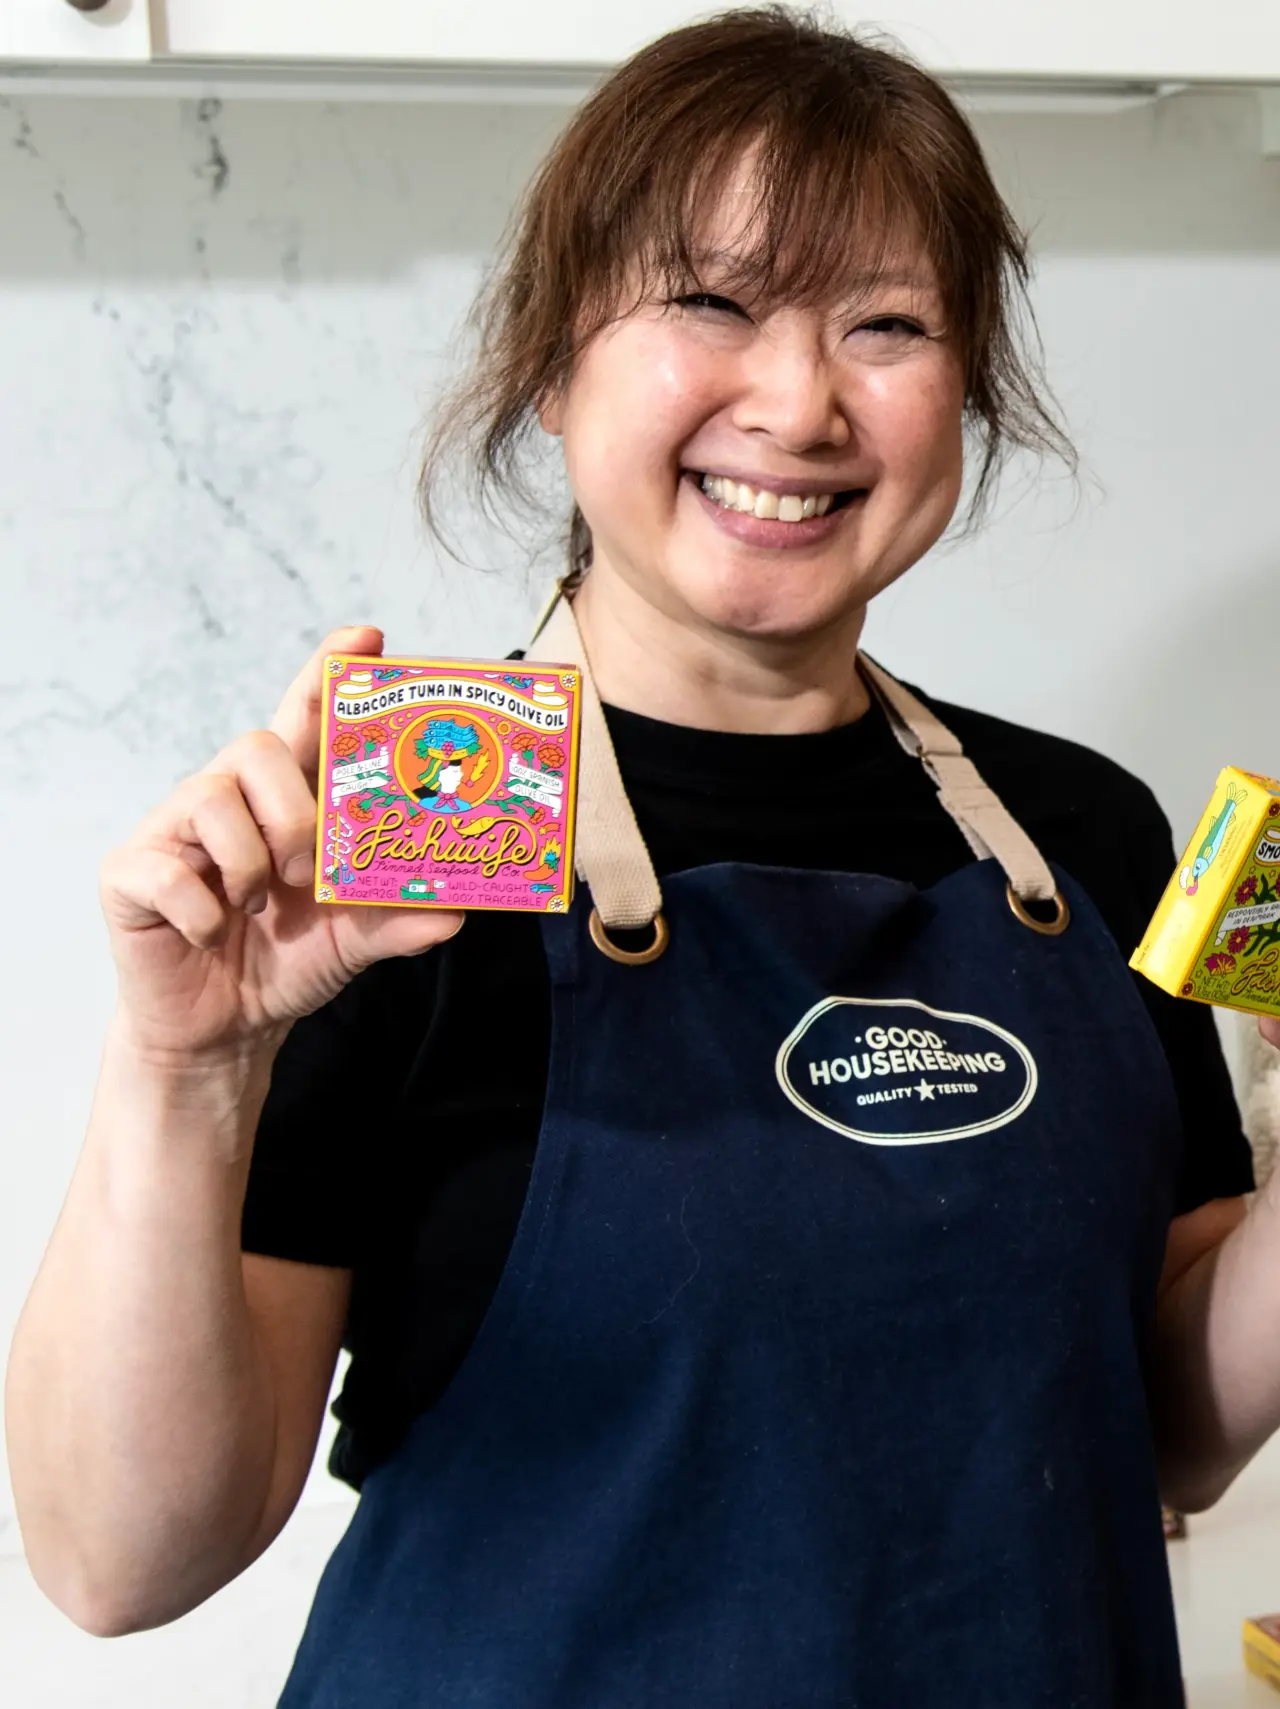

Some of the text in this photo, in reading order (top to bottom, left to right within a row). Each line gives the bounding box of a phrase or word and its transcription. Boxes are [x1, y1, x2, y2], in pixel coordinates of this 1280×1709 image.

[337, 684, 565, 727] ALBACORE TUNA IN SPICY OLIVE OIL
[515, 785, 537, 798] OLIVE
[352, 809, 537, 877] Fishwife
[426, 863, 480, 877] Seafood
[357, 876, 378, 886] NET
[448, 881, 529, 893] WILD-CAUGHT
[448, 893, 542, 906] 100% TRACEABLE
[865, 1026, 943, 1050] GOOD
[809, 1049, 1006, 1085] HOUSEKEEPING
[856, 1083, 979, 1106] QUALITY TESTED
